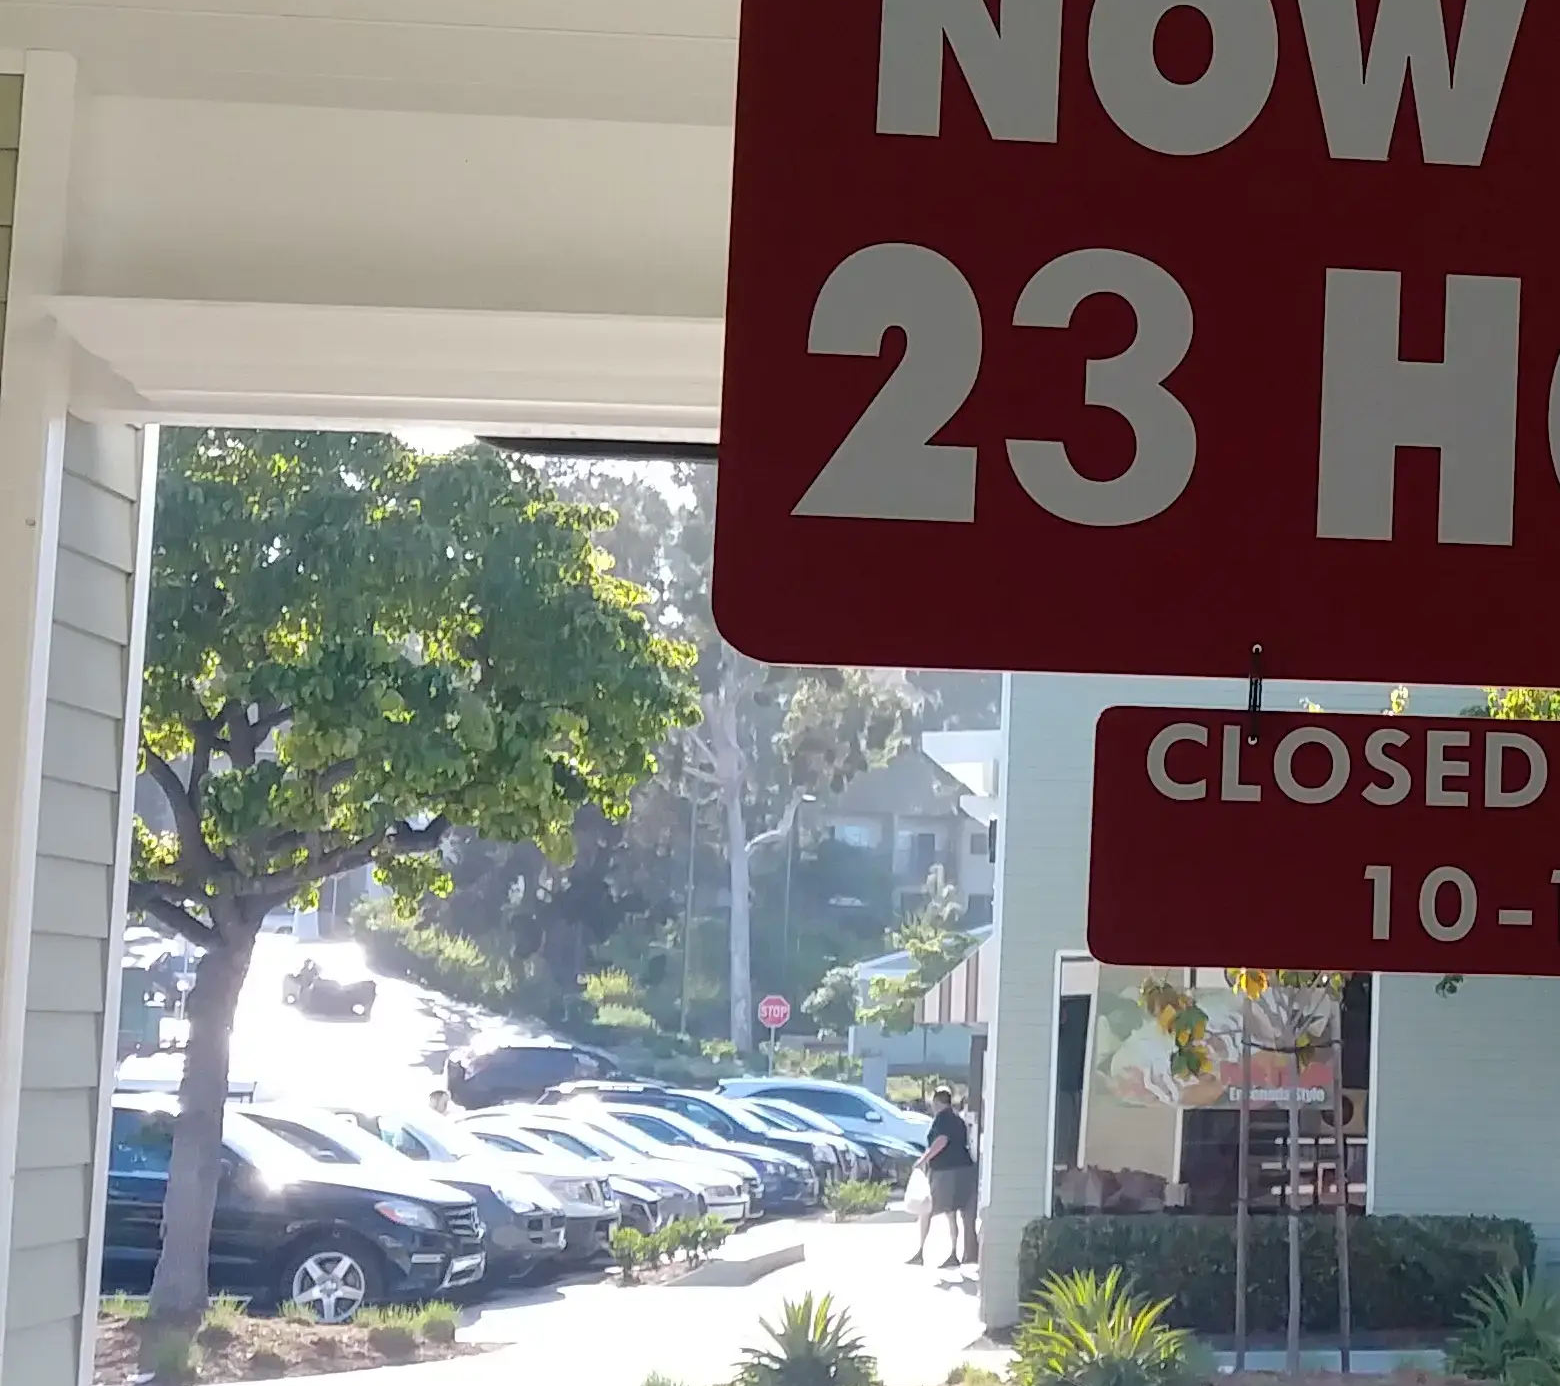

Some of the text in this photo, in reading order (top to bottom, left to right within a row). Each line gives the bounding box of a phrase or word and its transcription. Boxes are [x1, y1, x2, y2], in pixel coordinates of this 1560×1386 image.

[791, 243, 1196, 526] 23
[1147, 723, 1547, 807] CLOSED
[762, 1005, 787, 1017] STOP
